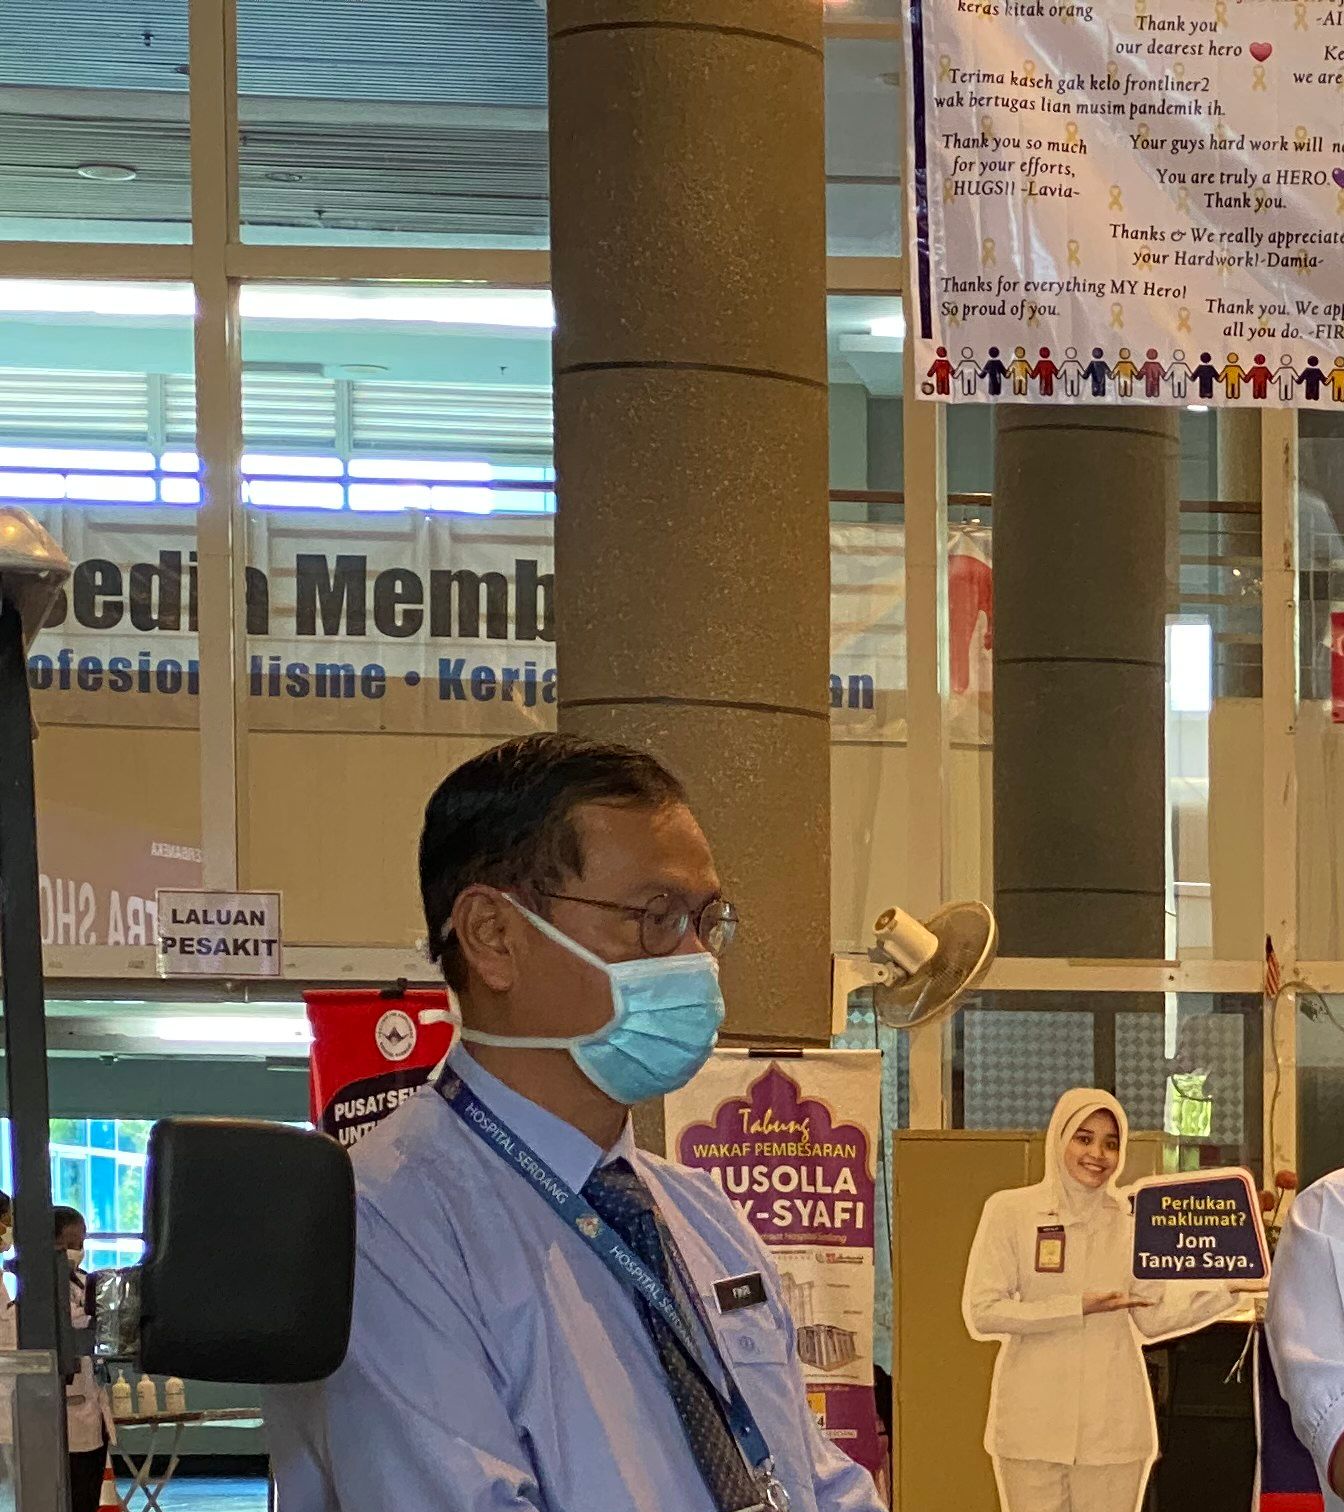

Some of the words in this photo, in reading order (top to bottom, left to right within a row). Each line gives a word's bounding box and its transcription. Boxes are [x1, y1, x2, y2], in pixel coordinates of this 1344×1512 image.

[1115, 43, 1143, 54] our
[1146, 38, 1204, 56] dearest
[1208, 39, 1243, 57] hero
[953, 180, 1015, 196] HUGS!!
[1021, 180, 1080, 198] -Lavia-
[1109, 223, 1166, 242] Thanks
[1170, 230, 1187, 242] &
[1191, 227, 1215, 243] We
[1219, 226, 1264, 248] really
[296, 553, 556, 642] Memb
[170, 907, 267, 927] LALUAN
[161, 937, 278, 957] PESAKIT
[738, 1108, 811, 1142] Tabung
[465, 1102, 516, 1155] HOSPITAL
[514, 1149, 570, 1205] SERDANG
[693, 1144, 751, 1159] WAKAF
[754, 1142, 857, 1159] PEMBESARAN
[1161, 1195, 1236, 1210] Perlukan
[1151, 1211, 1247, 1226] maklumat?
[1176, 1232, 1217, 1248] Jom
[1138, 1252, 1196, 1272] Tanya
[1202, 1251, 1255, 1272] Saya.
[608, 1246, 662, 1305] HOSPITAL
